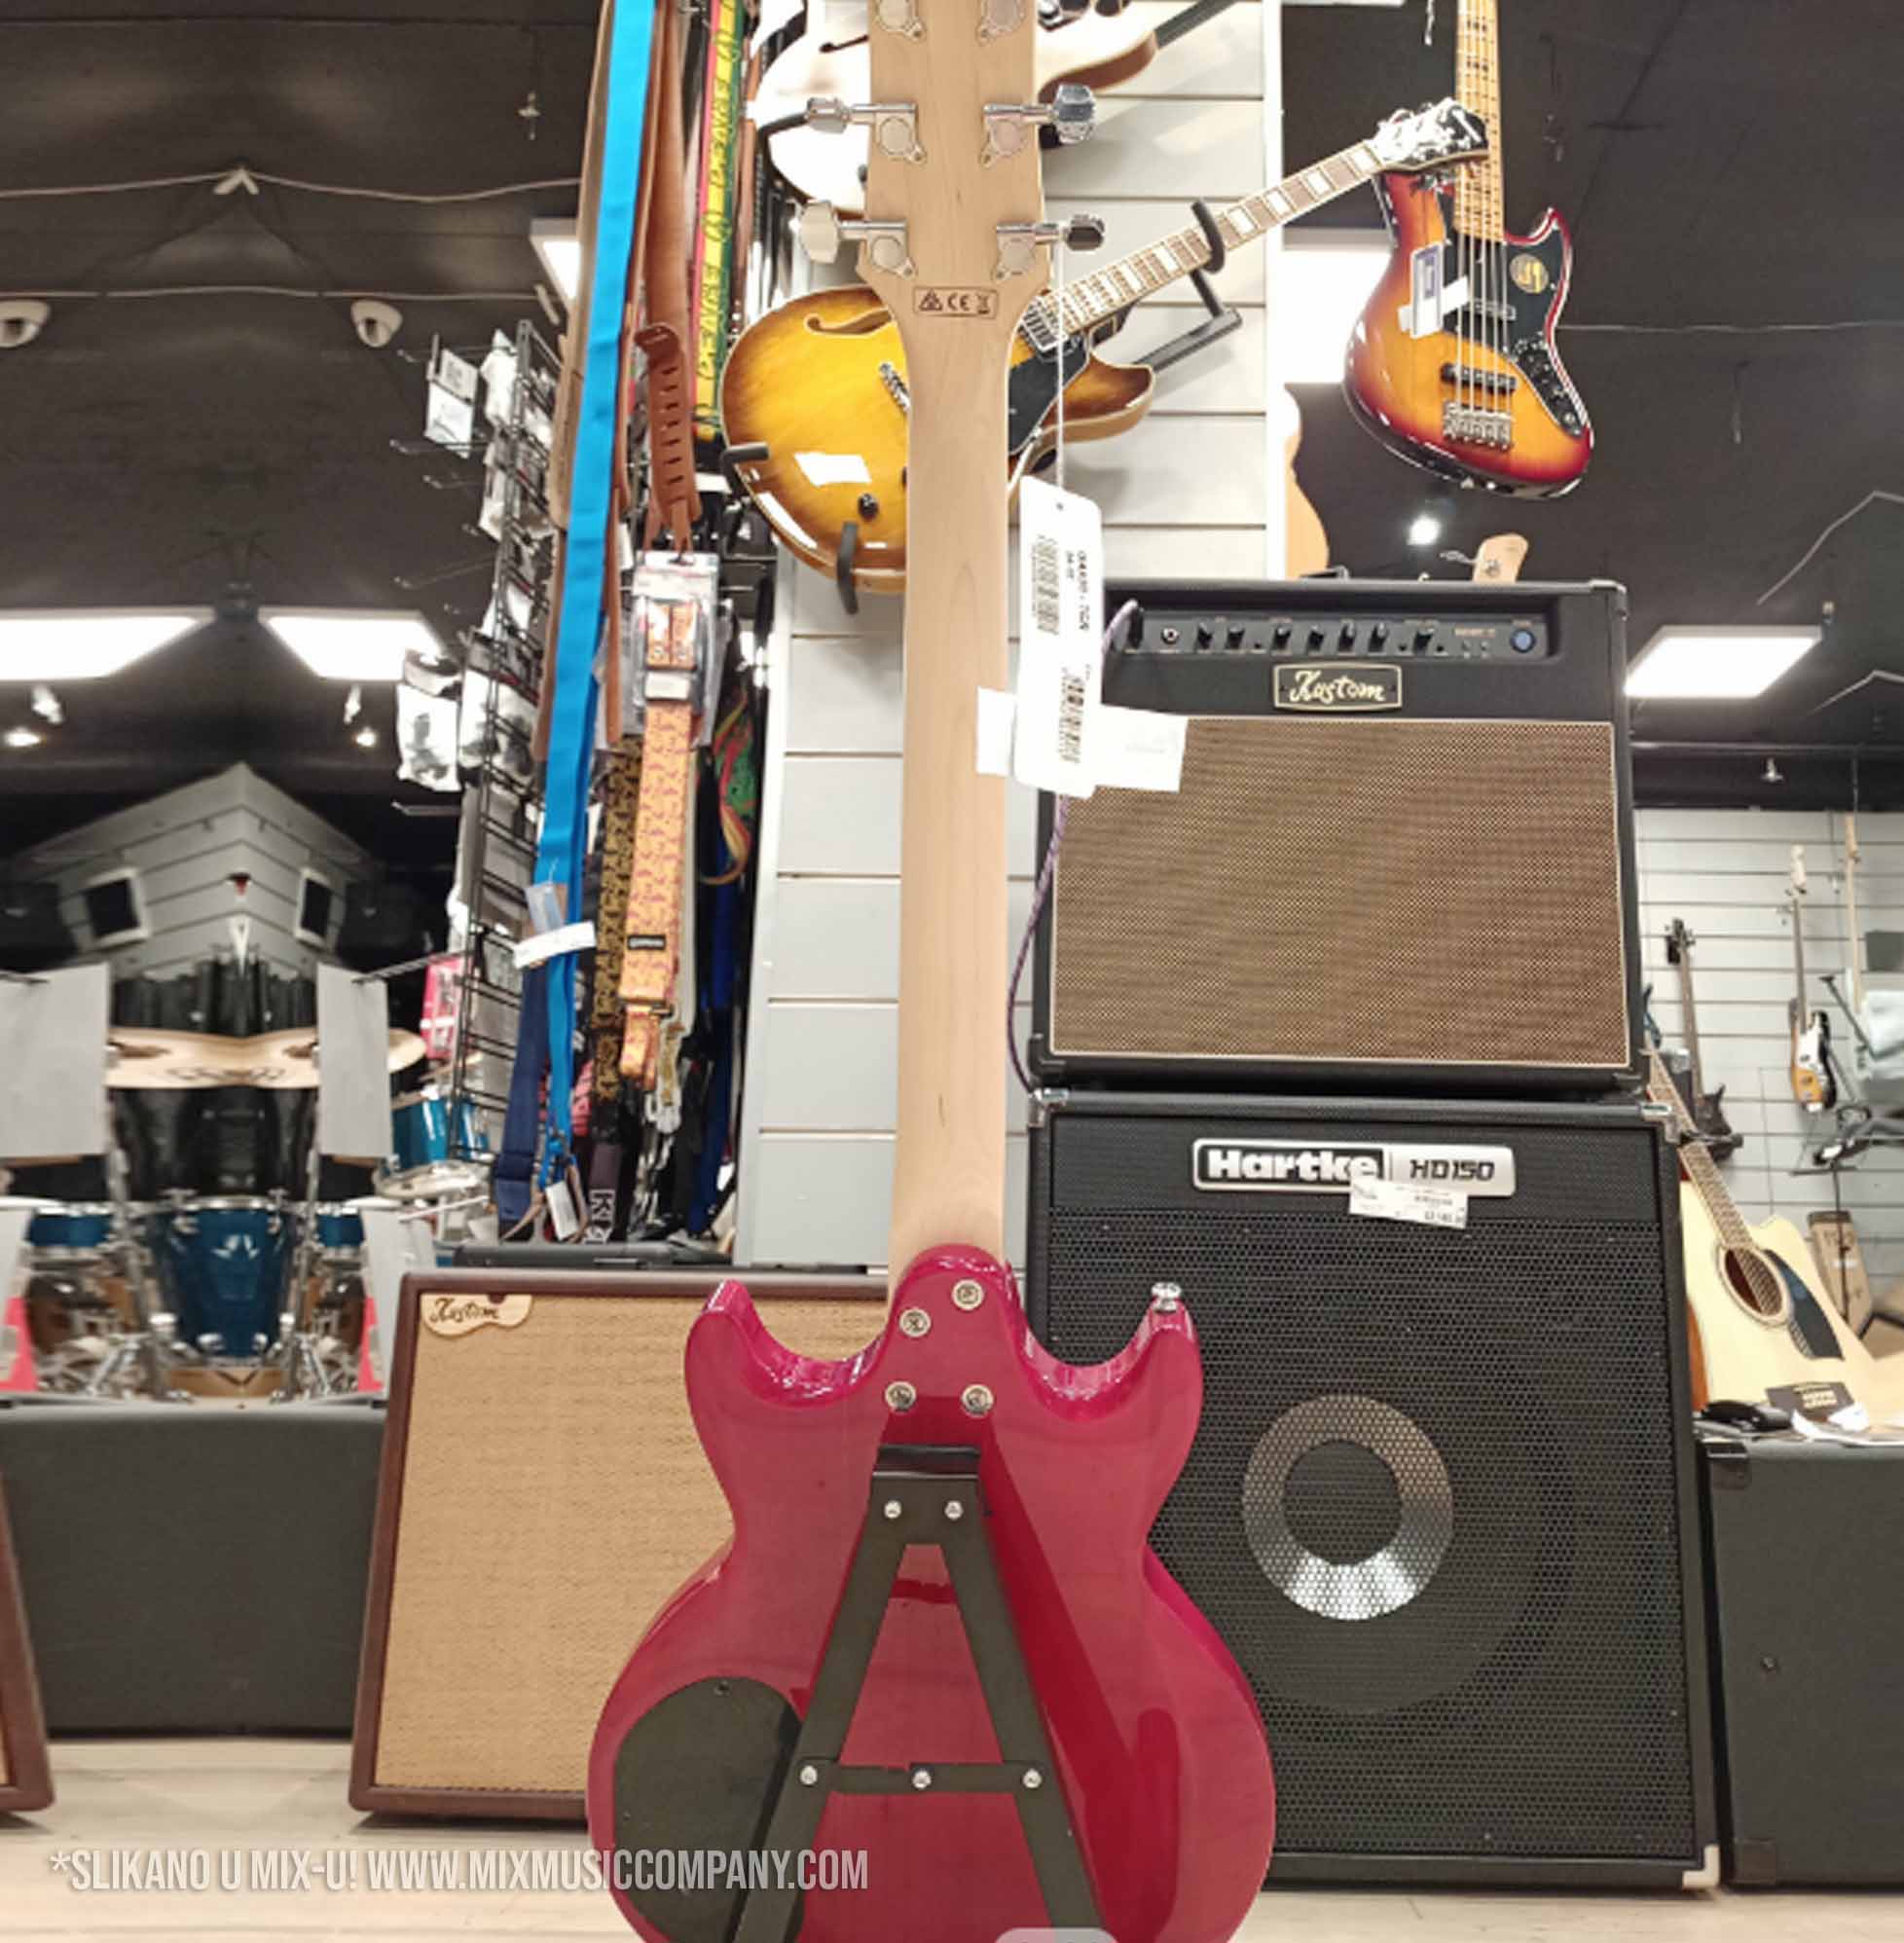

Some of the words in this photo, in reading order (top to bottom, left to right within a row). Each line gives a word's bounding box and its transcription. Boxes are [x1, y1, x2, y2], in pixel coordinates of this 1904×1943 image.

[1289, 670, 1386, 705] Kustom
[1207, 1149, 1379, 1181] Hartke
[1410, 1158, 1496, 1182] HD150
